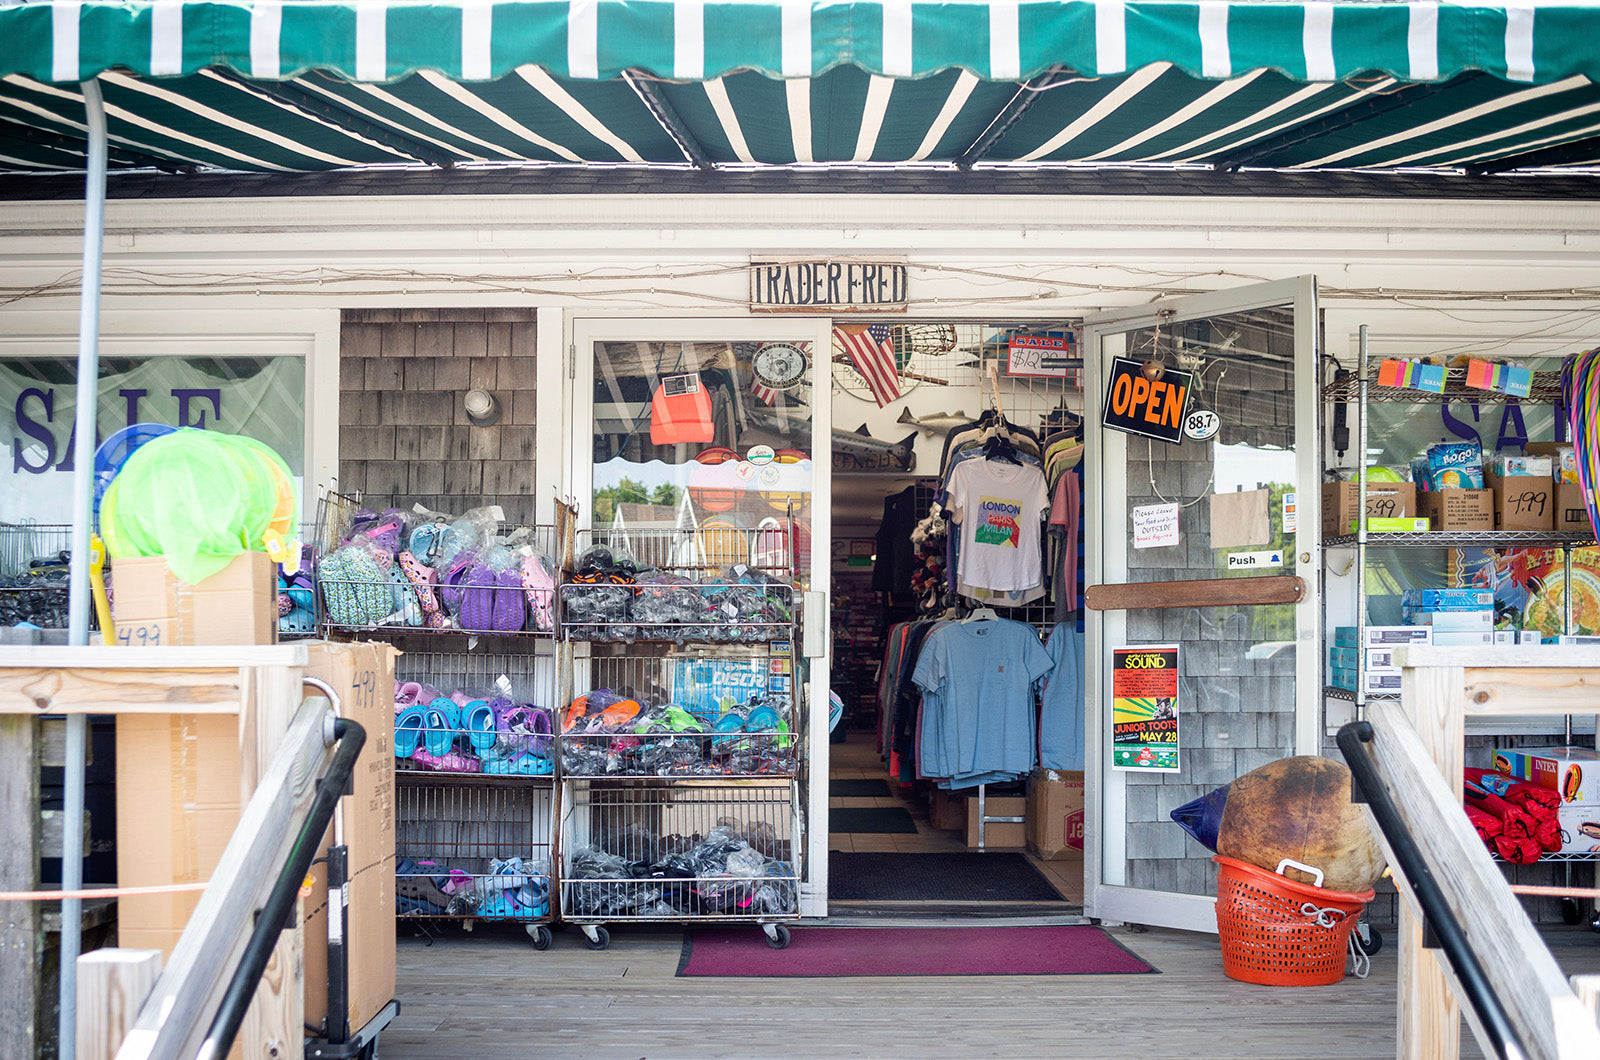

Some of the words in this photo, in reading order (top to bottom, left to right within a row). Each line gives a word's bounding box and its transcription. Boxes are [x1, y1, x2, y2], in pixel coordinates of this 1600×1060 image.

[751, 262, 841, 304] TRADER
[848, 262, 907, 304] FRED
[1016, 338, 1063, 347] SALE
[1112, 373, 1186, 429] OPEN
[1188, 414, 1213, 431] 88.7
[982, 501, 1021, 515] LONDON
[1366, 499, 1396, 518] 5.99
[1507, 491, 1547, 517] 4.99
[988, 513, 1013, 524] PARIS
[983, 523, 1013, 536] MILAN
[1229, 556, 1256, 565] Push
[1125, 657, 1166, 669] SOUND
[1114, 722, 1146, 734] JUNIOR
[1147, 720, 1177, 731] TOOTS
[1140, 731, 1164, 742] MAY
[1165, 731, 1178, 742] 28
[1535, 759, 1558, 773] INTEX
